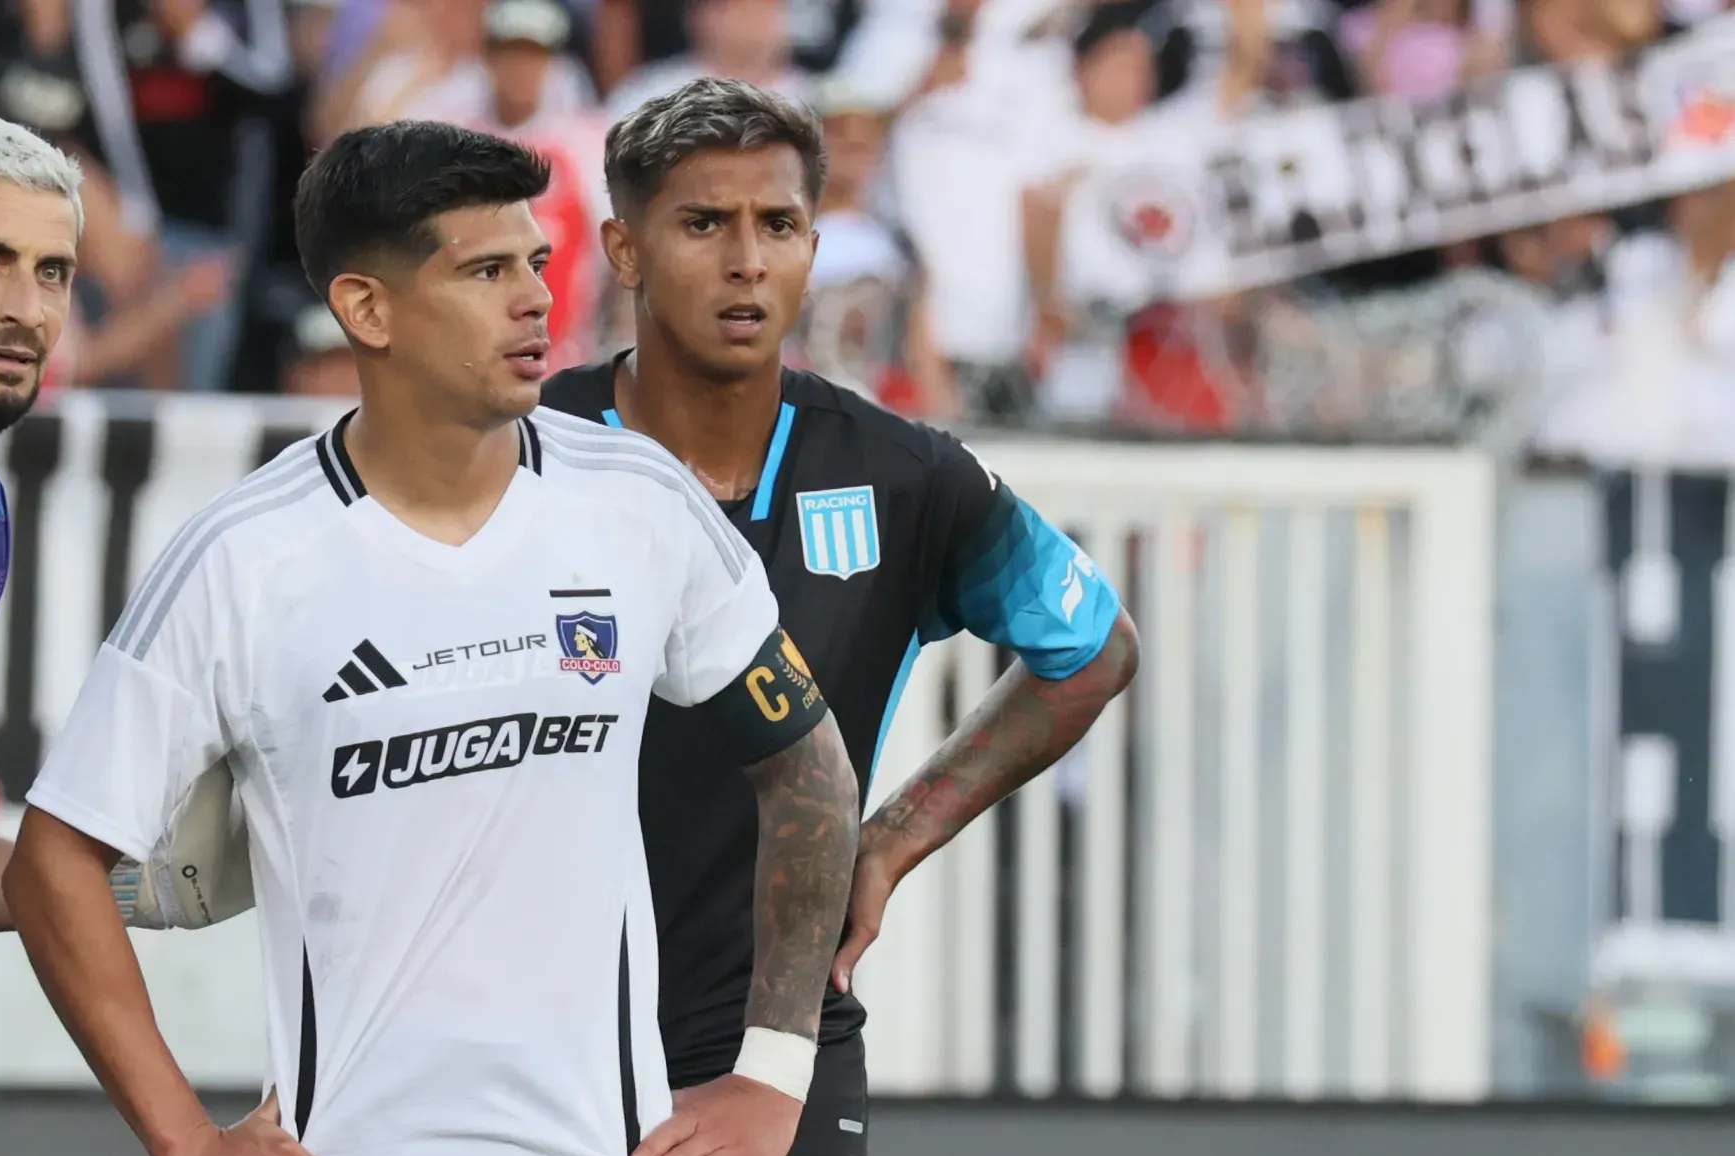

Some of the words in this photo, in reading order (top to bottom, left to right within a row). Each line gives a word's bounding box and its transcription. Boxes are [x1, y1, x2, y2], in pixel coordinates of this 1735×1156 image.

[804, 494, 868, 511] RACING
[413, 634, 547, 670] JETOUR
[561, 659, 619, 672] COLO-COLO
[746, 666, 790, 722] C
